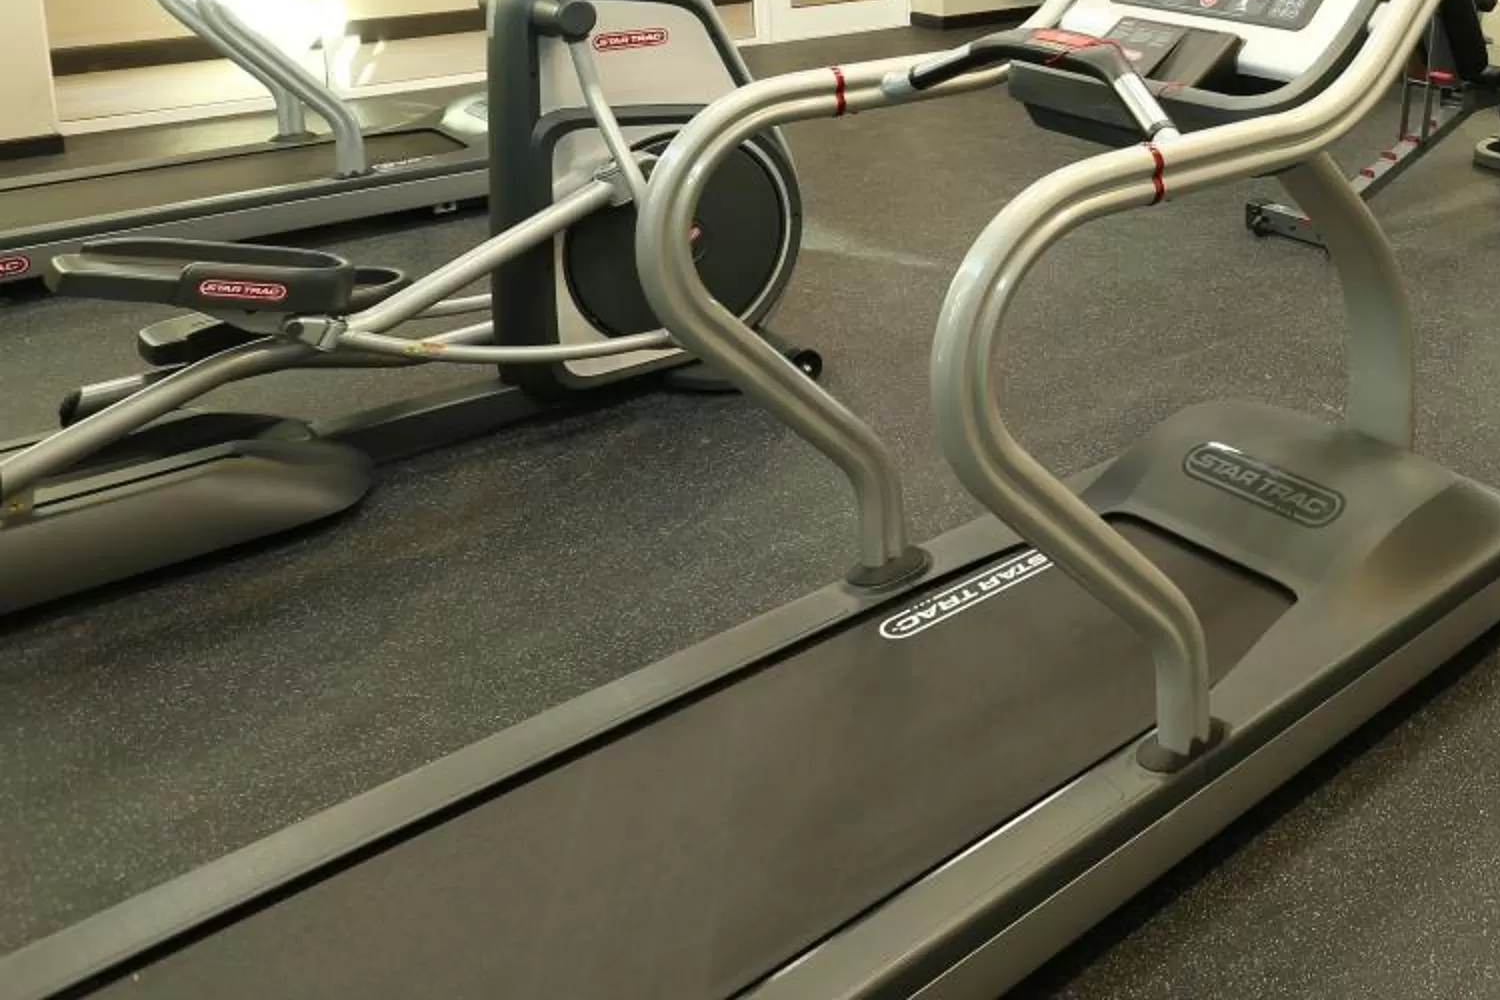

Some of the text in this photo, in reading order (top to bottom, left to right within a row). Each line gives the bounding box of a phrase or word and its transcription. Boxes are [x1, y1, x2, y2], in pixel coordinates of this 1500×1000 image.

[204, 283, 280, 295] STAR TRAC
[1192, 453, 1328, 513] STAR TRAC
[895, 552, 1049, 629] STAR TRAC
